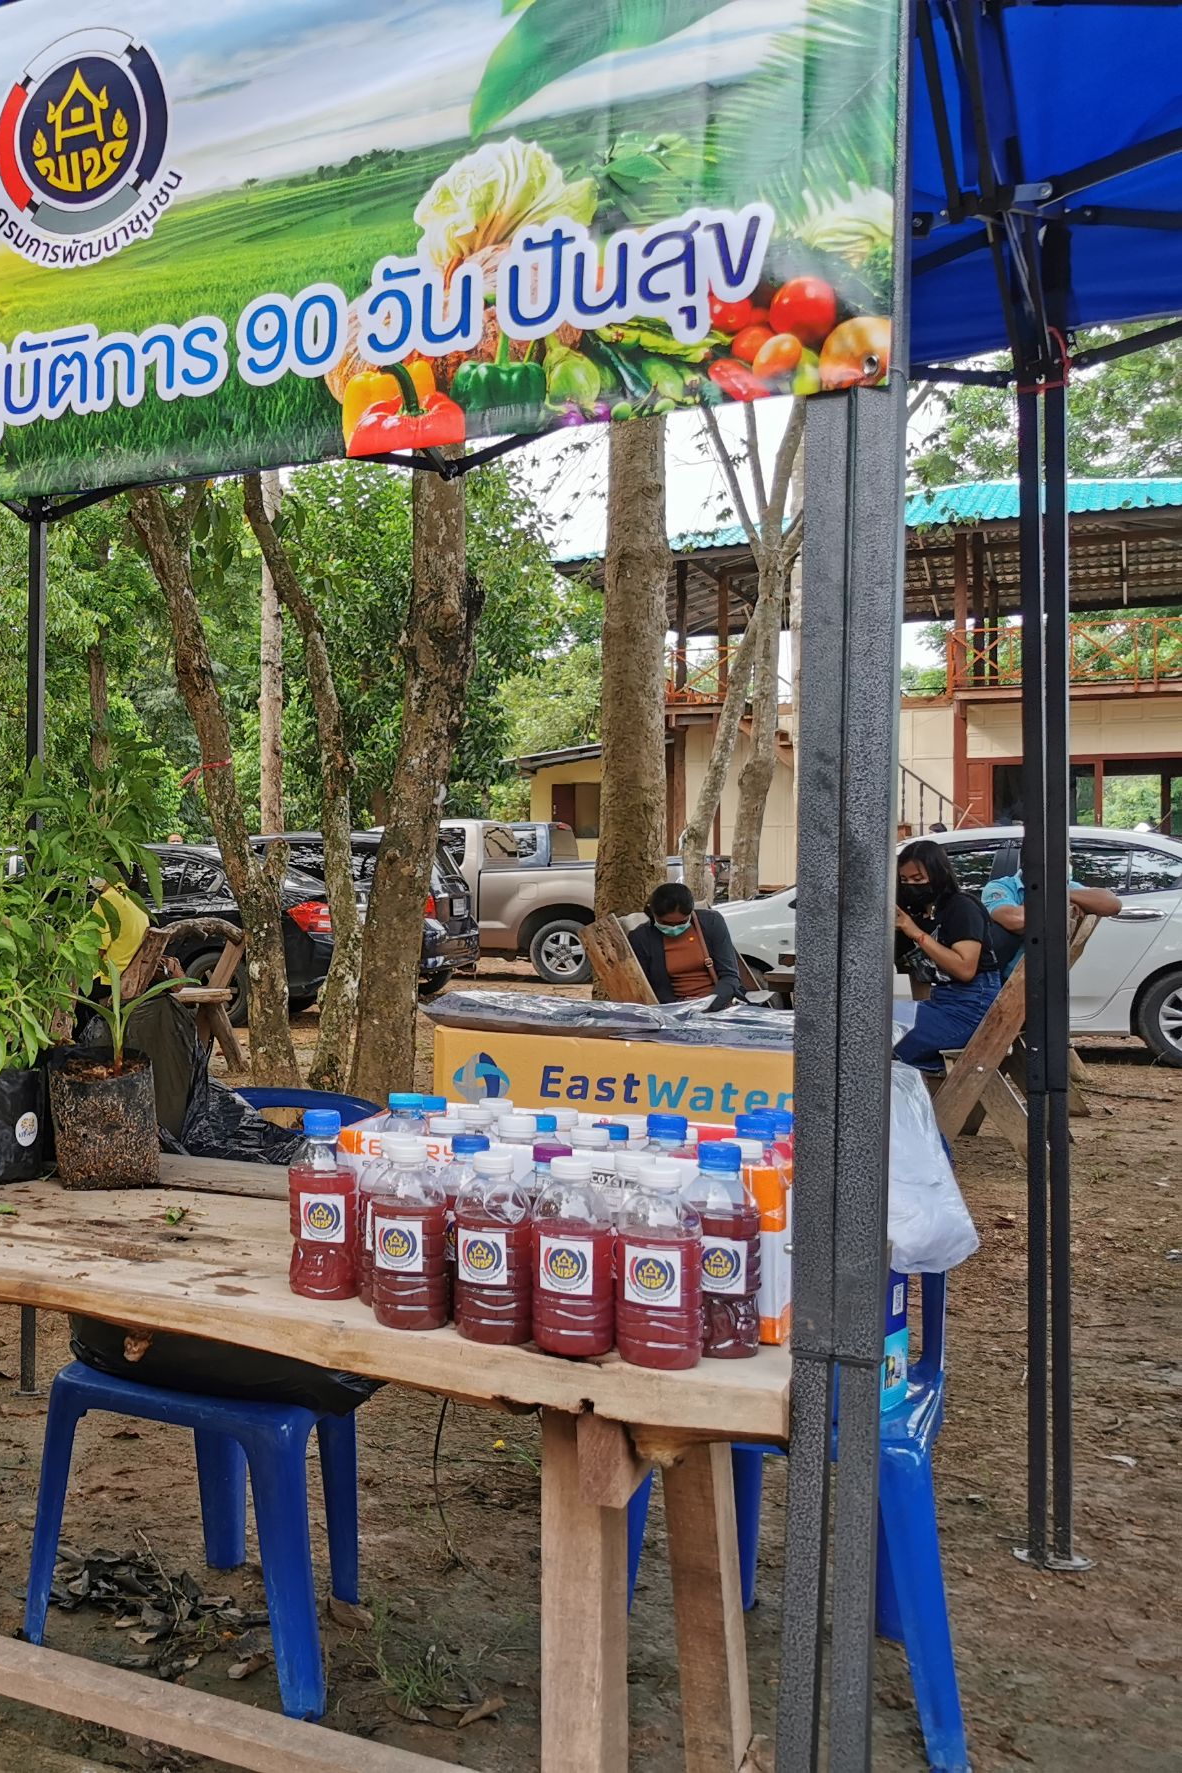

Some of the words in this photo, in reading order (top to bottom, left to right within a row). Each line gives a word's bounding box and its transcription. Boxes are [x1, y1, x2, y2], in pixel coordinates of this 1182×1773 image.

[246, 294, 338, 374] 90
[367, 266, 472, 352] วัน
[507, 214, 762, 330] ปันสุข
